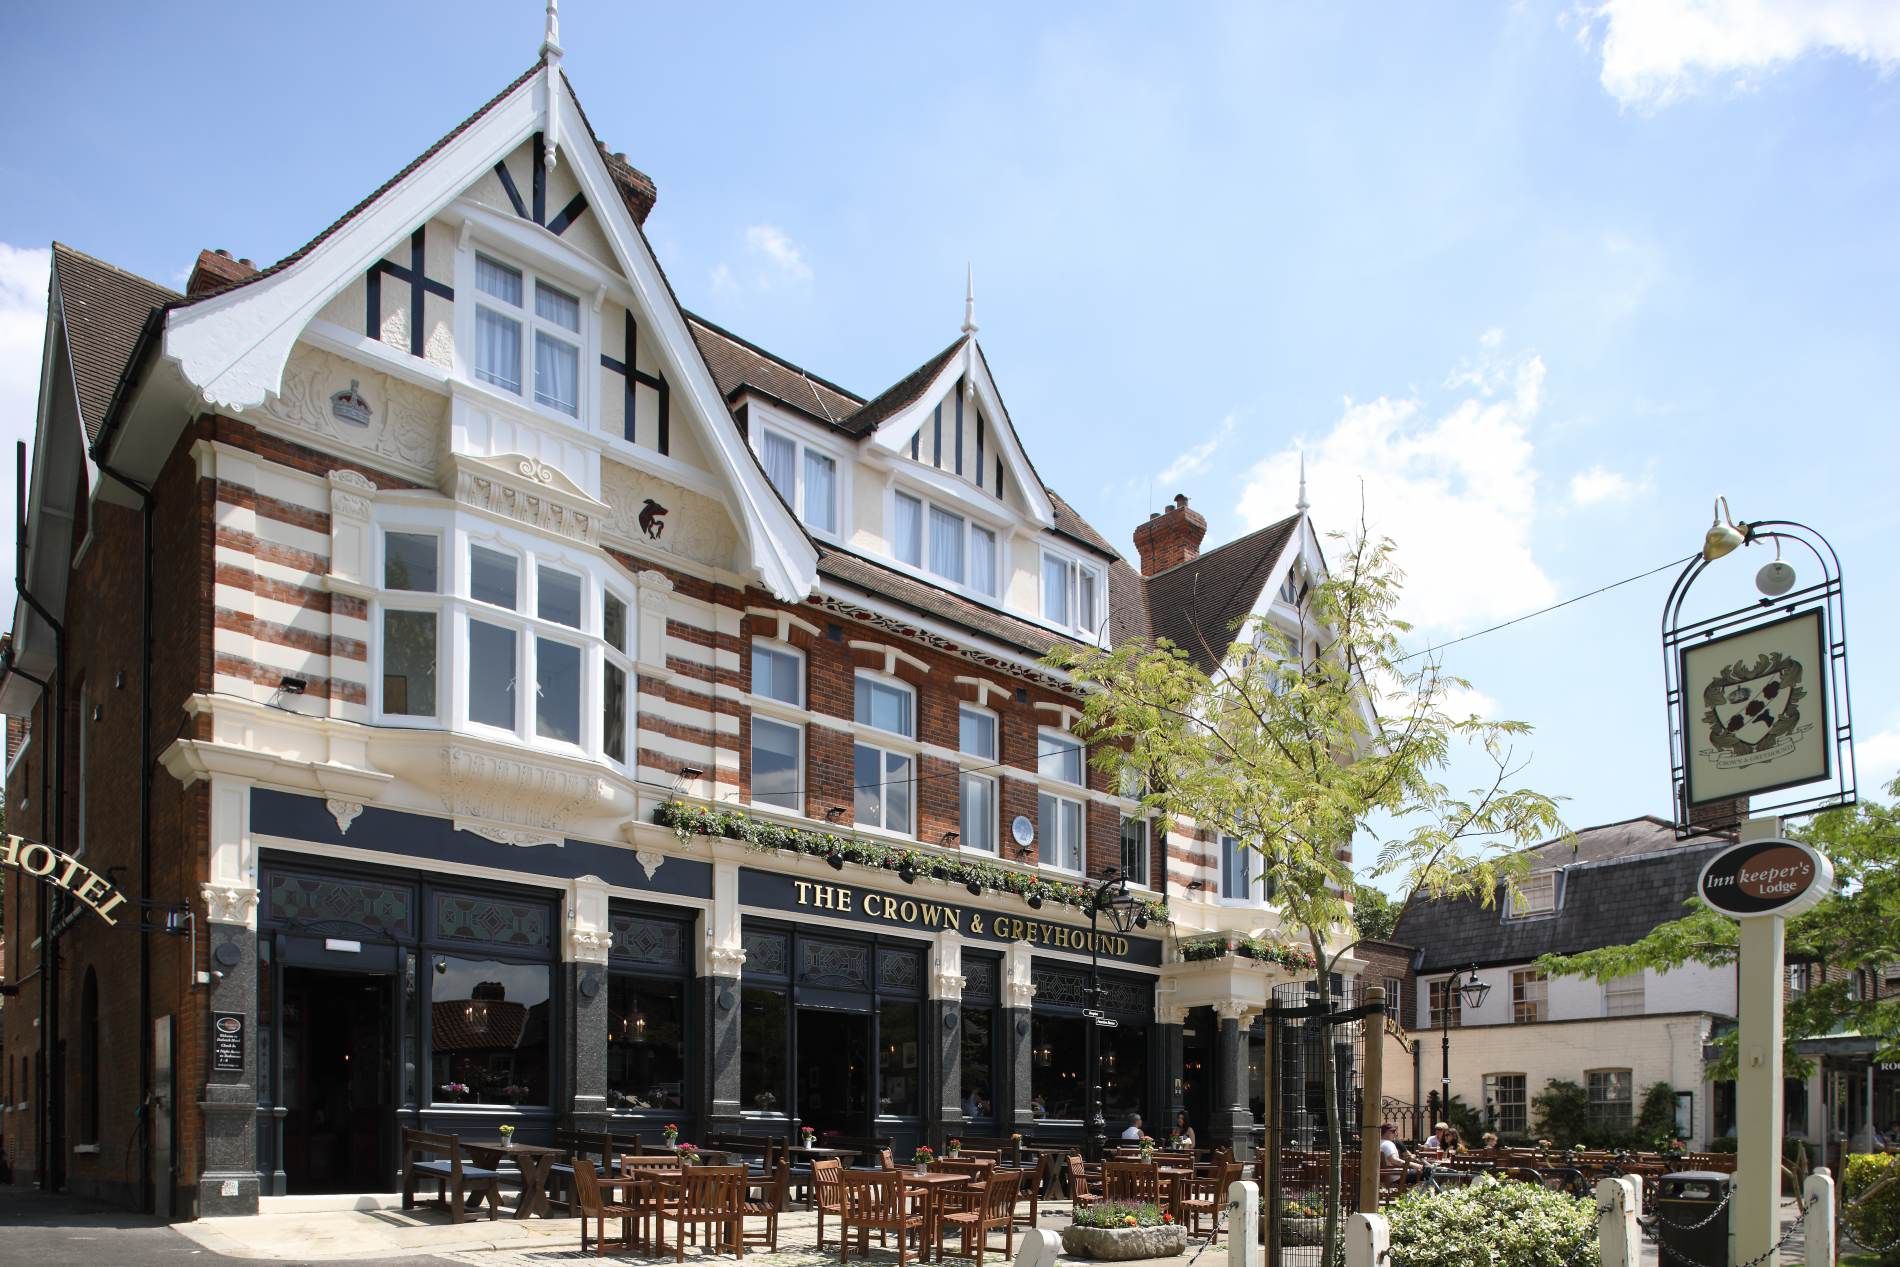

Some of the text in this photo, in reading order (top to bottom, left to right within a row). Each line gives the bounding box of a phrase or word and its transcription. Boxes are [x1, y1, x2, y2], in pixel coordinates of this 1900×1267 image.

[1759, 881, 1798, 894] Lodge
[794, 881, 1129, 956] THE CROWN & GREYHOUND
